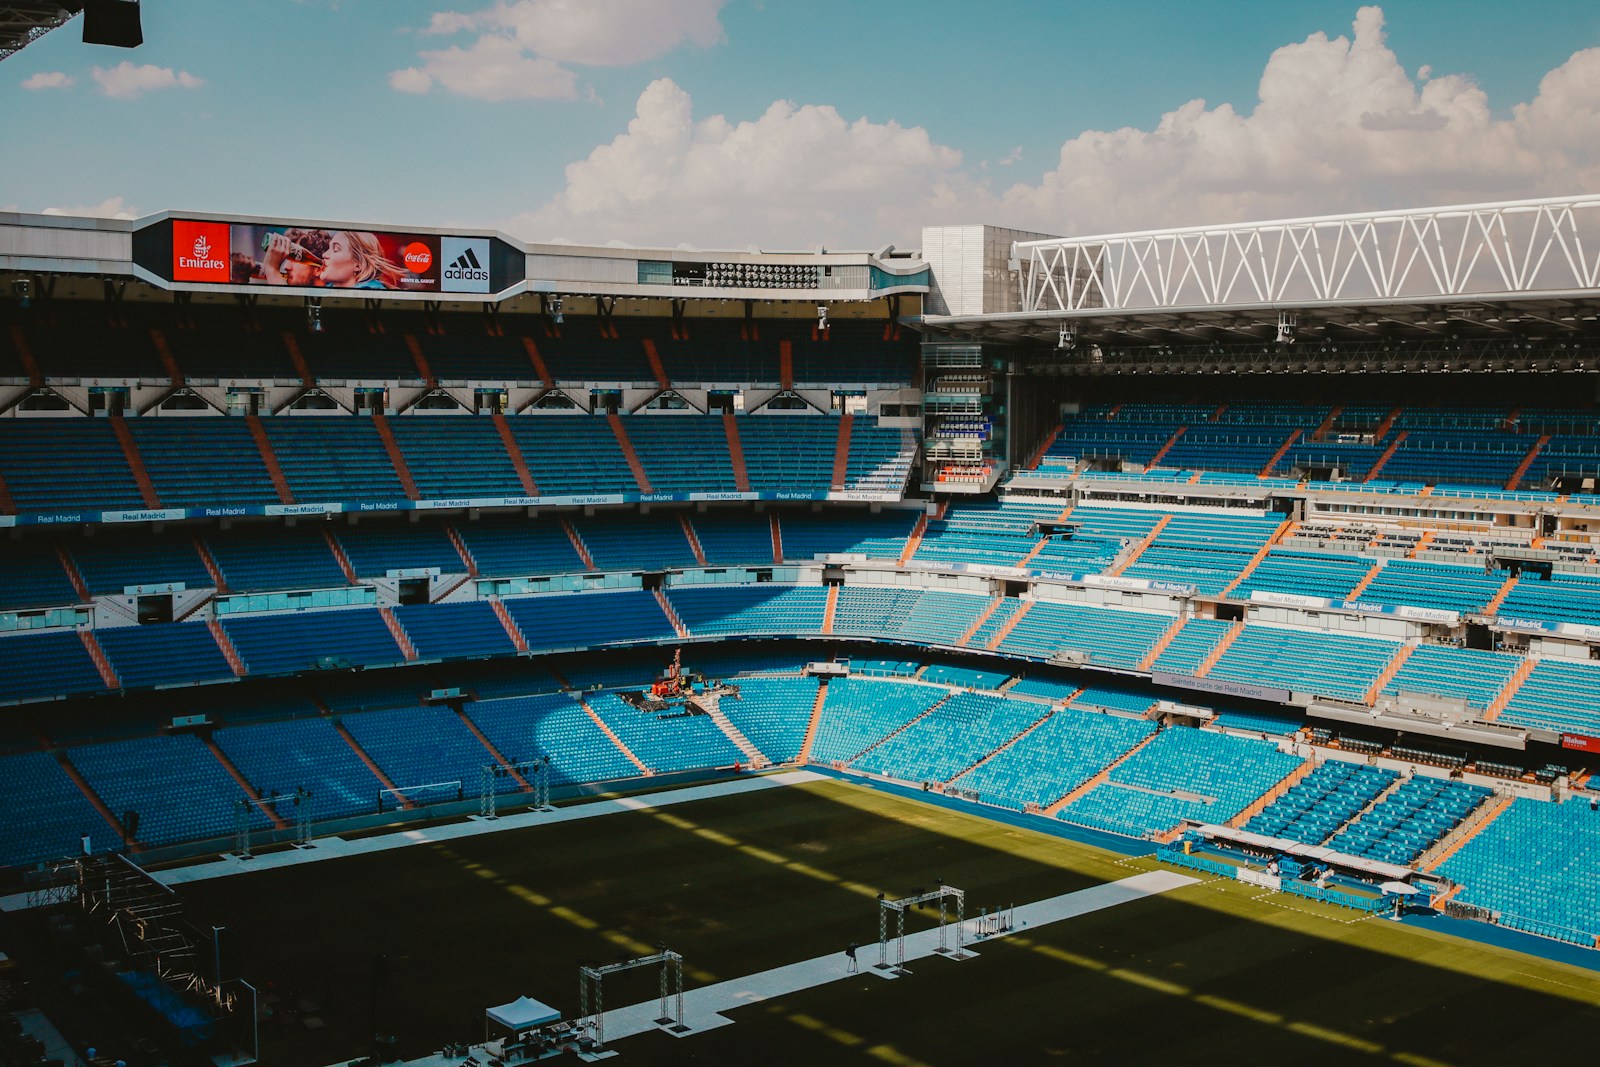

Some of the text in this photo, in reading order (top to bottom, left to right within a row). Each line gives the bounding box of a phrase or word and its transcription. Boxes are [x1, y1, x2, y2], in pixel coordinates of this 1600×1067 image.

[179, 256, 224, 270] Emirates
[444, 267, 488, 280] adidas
[38, 514, 80, 523] Real Madrid
[140, 512, 165, 520] Madrid
[1166, 583, 1187, 591] Madrid
[1284, 597, 1306, 605] Madrid
[1342, 602, 1382, 612] Real Madrid
[1424, 612, 1449, 620] Madrid
[1498, 618, 1541, 629] Real Madrid
[1584, 628, 1600, 637] Rea
[1196, 681, 1212, 689] parte
[1225, 685, 1238, 693] Real
[1240, 688, 1262, 697] Madrid
[1564, 736, 1587, 746] Mahou
